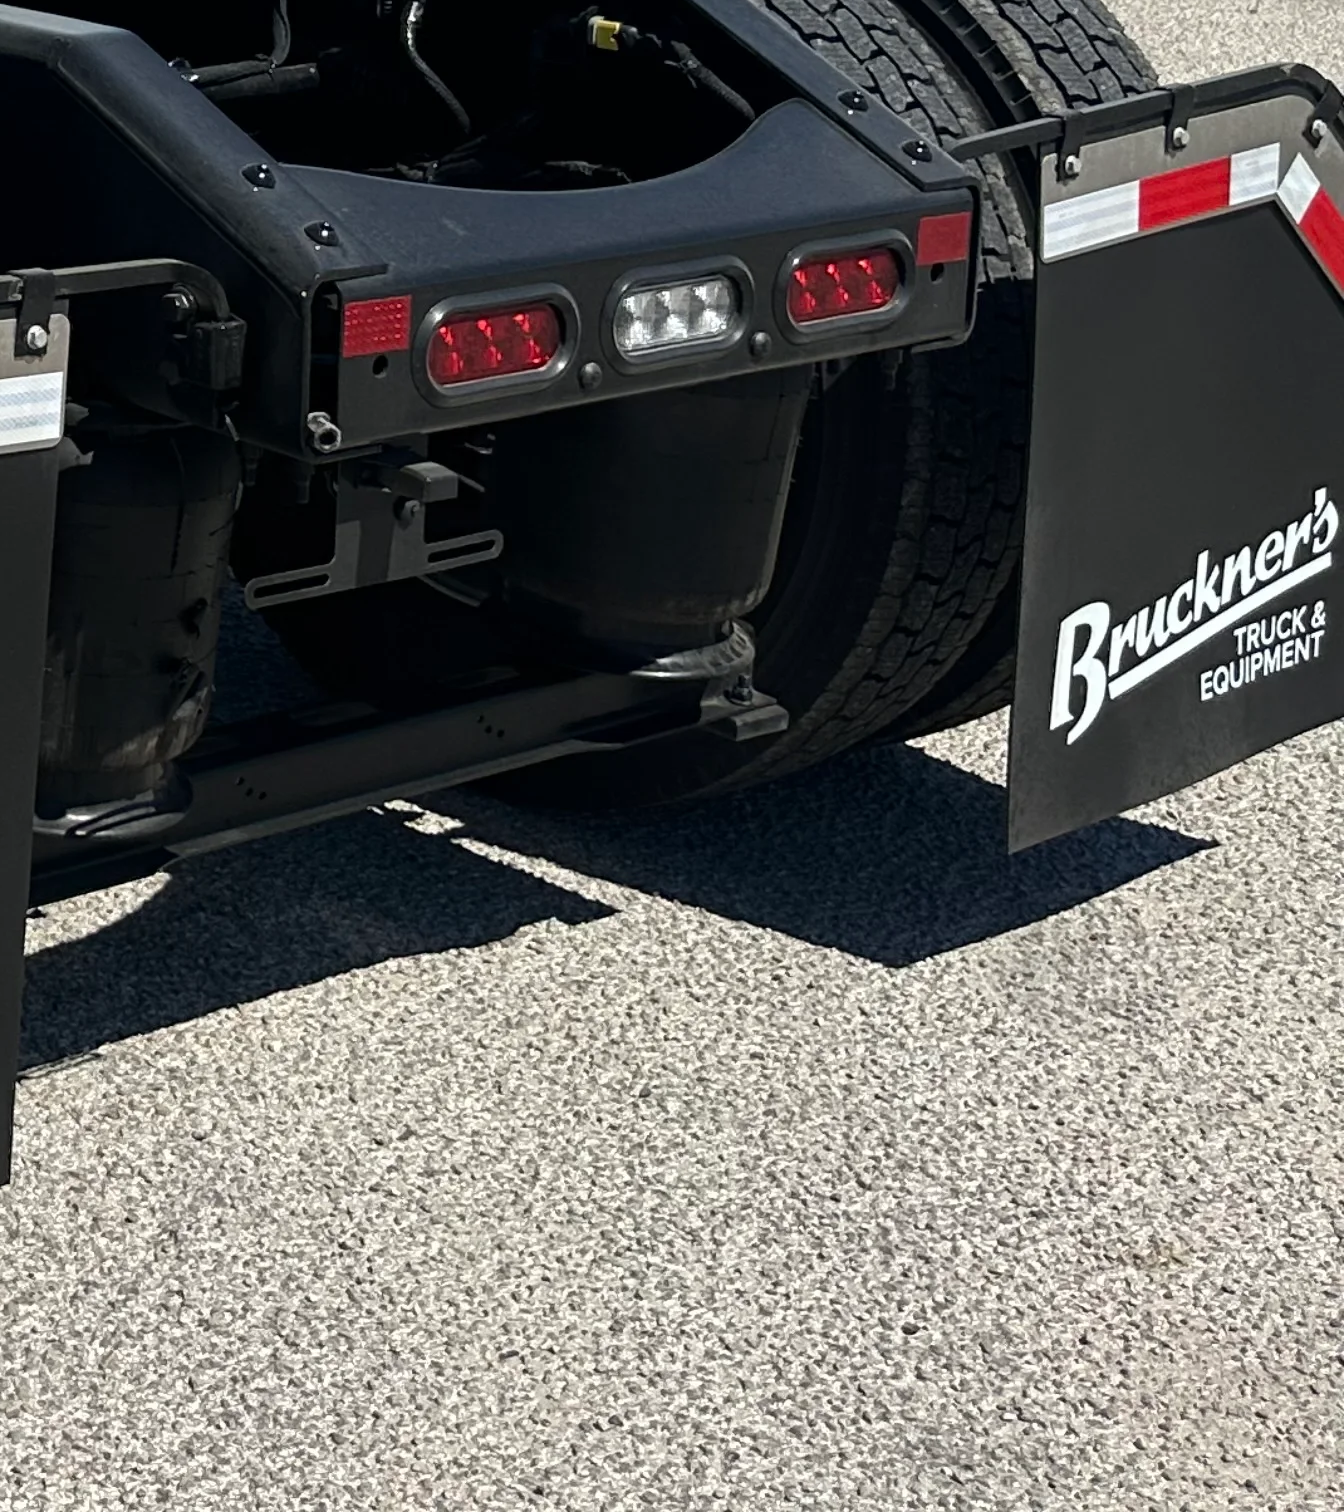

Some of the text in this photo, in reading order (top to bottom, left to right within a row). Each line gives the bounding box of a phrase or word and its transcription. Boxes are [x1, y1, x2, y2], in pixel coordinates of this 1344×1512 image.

[1049, 487, 1339, 746] Bruckner's
[1233, 600, 1326, 656] TRUCK &
[1200, 630, 1326, 702] EQUIPMENT
